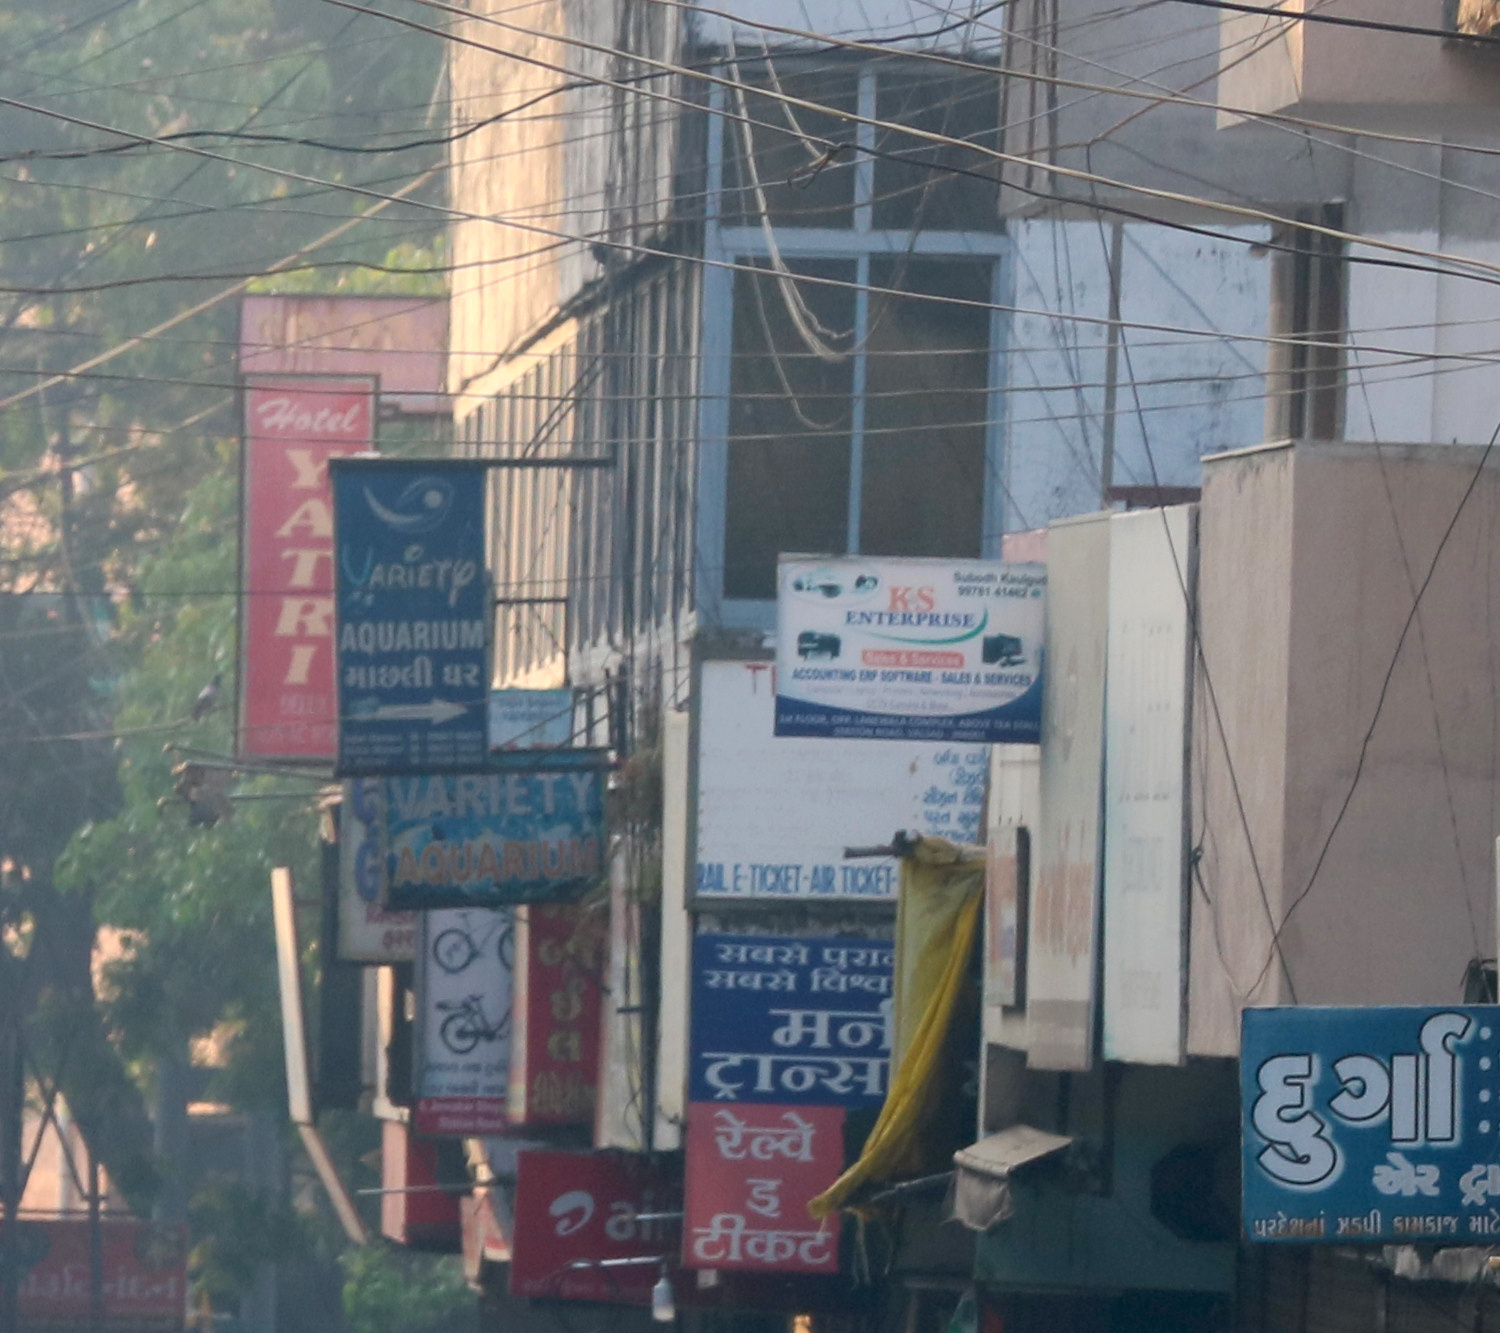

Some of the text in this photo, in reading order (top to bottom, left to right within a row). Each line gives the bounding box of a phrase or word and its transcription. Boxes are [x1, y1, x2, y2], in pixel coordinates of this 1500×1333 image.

[256, 398, 362, 434] Hotel
[274, 447, 334, 686] YATRI
[887, 585, 936, 613] KS
[341, 620, 485, 652] AQUARIUM
[844, 611, 976, 628] ENTERPRISE
[344, 654, 434, 689] માછલી
[791, 668, 857, 682] ACCOUNTING
[880, 670, 933, 684] SOFTWARE
[387, 772, 595, 822] VARIETY
[395, 838, 600, 888] AQUARIUM
[715, 943, 808, 966] सबसे
[702, 969, 797, 991] सबसे
[1252, 1011, 1473, 1186] દુર્ગા
[713, 1112, 816, 1163] रेल्वे
[1371, 1152, 1441, 1197] એર
[746, 1178, 782, 1219] इ
[692, 1213, 833, 1264] टीकट
